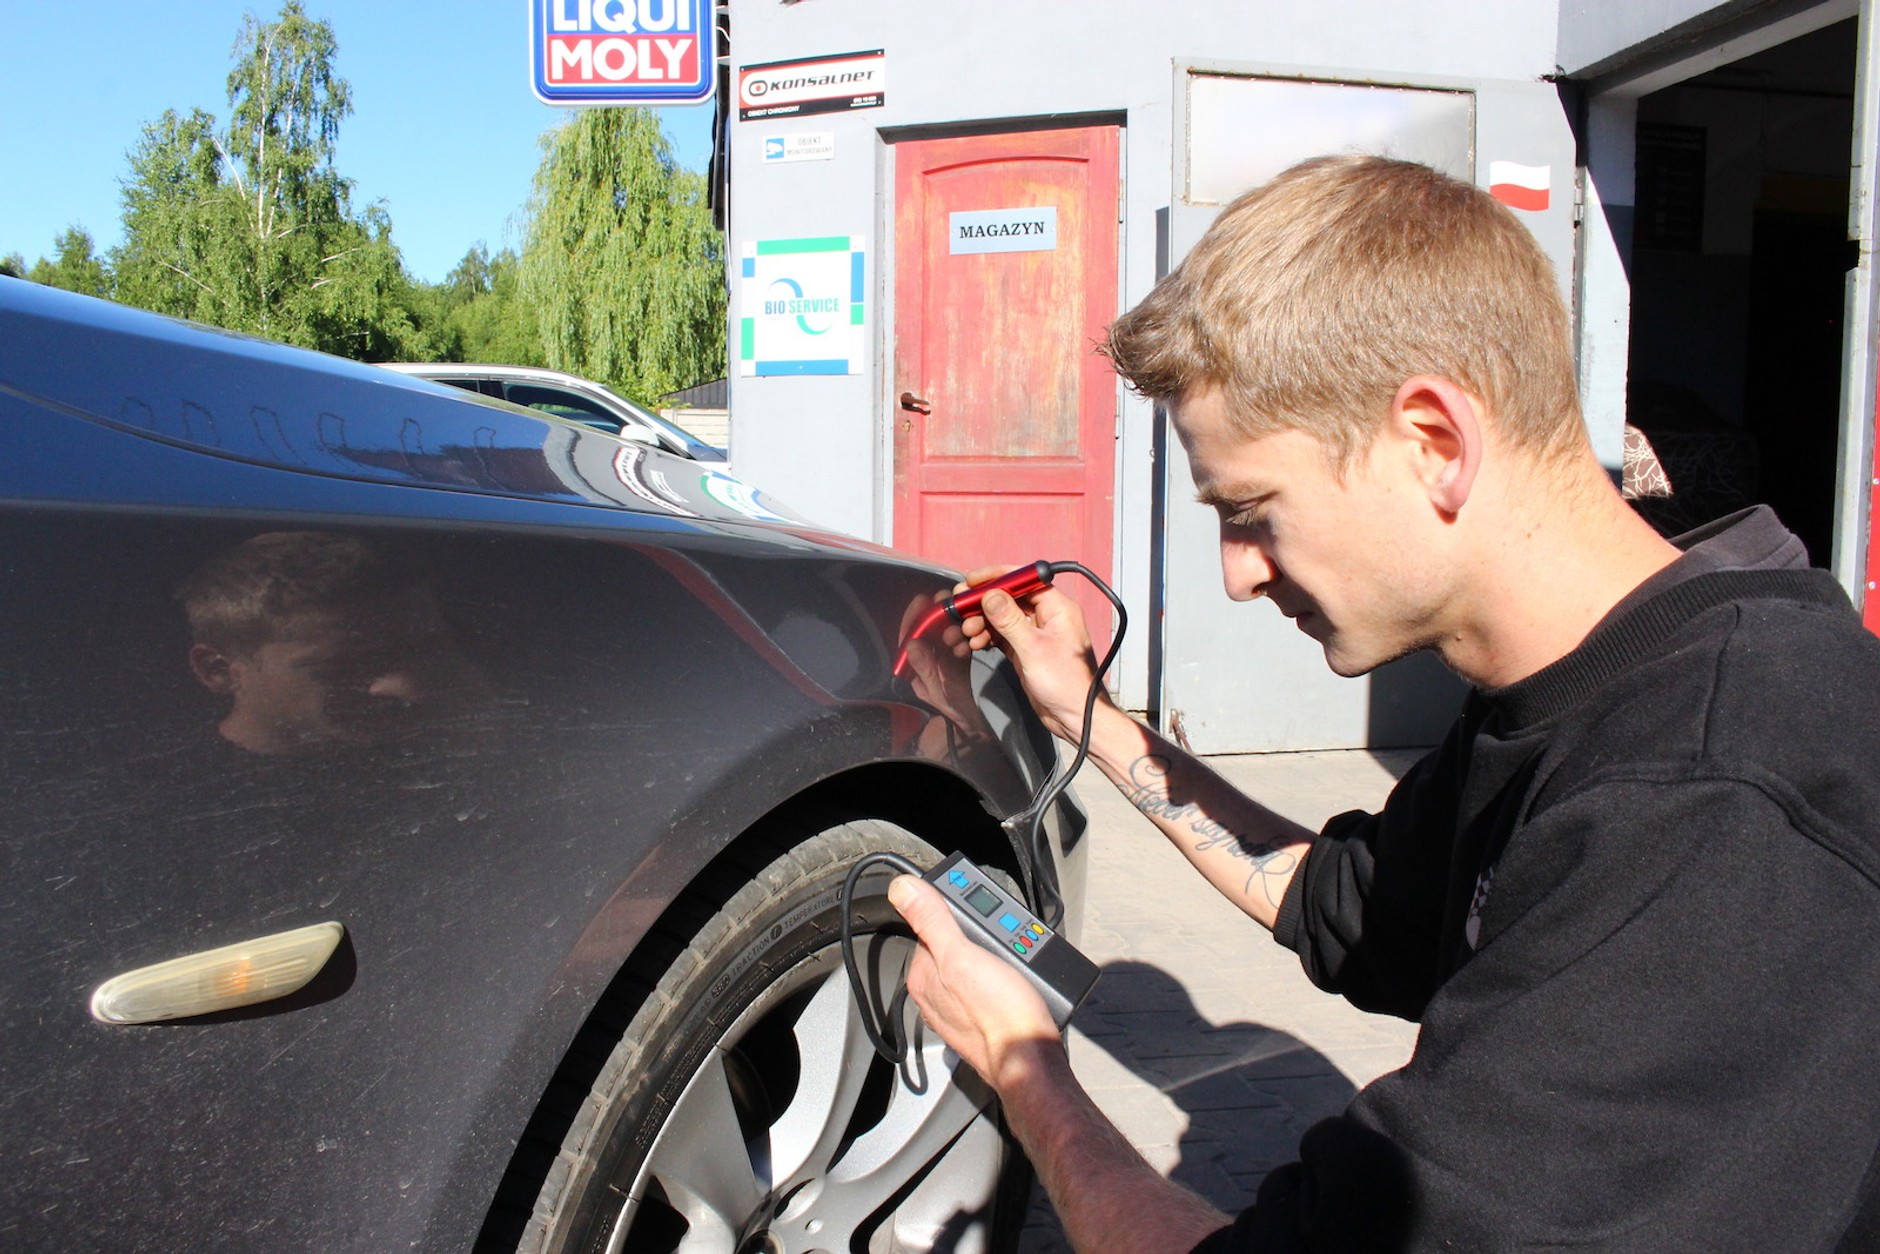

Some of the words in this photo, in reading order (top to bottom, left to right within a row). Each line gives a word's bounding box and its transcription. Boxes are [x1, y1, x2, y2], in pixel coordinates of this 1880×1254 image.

[553, 0, 690, 34] LIQUI
[551, 38, 693, 81] MOLY
[797, 137, 822, 146] OBIEKT
[959, 221, 1046, 239] MAGAZYN
[764, 300, 786, 315] BIO
[788, 298, 840, 314] SERVICE
[732, 938, 771, 976] TRACTION
[783, 898, 834, 930] TEMPERATURE
